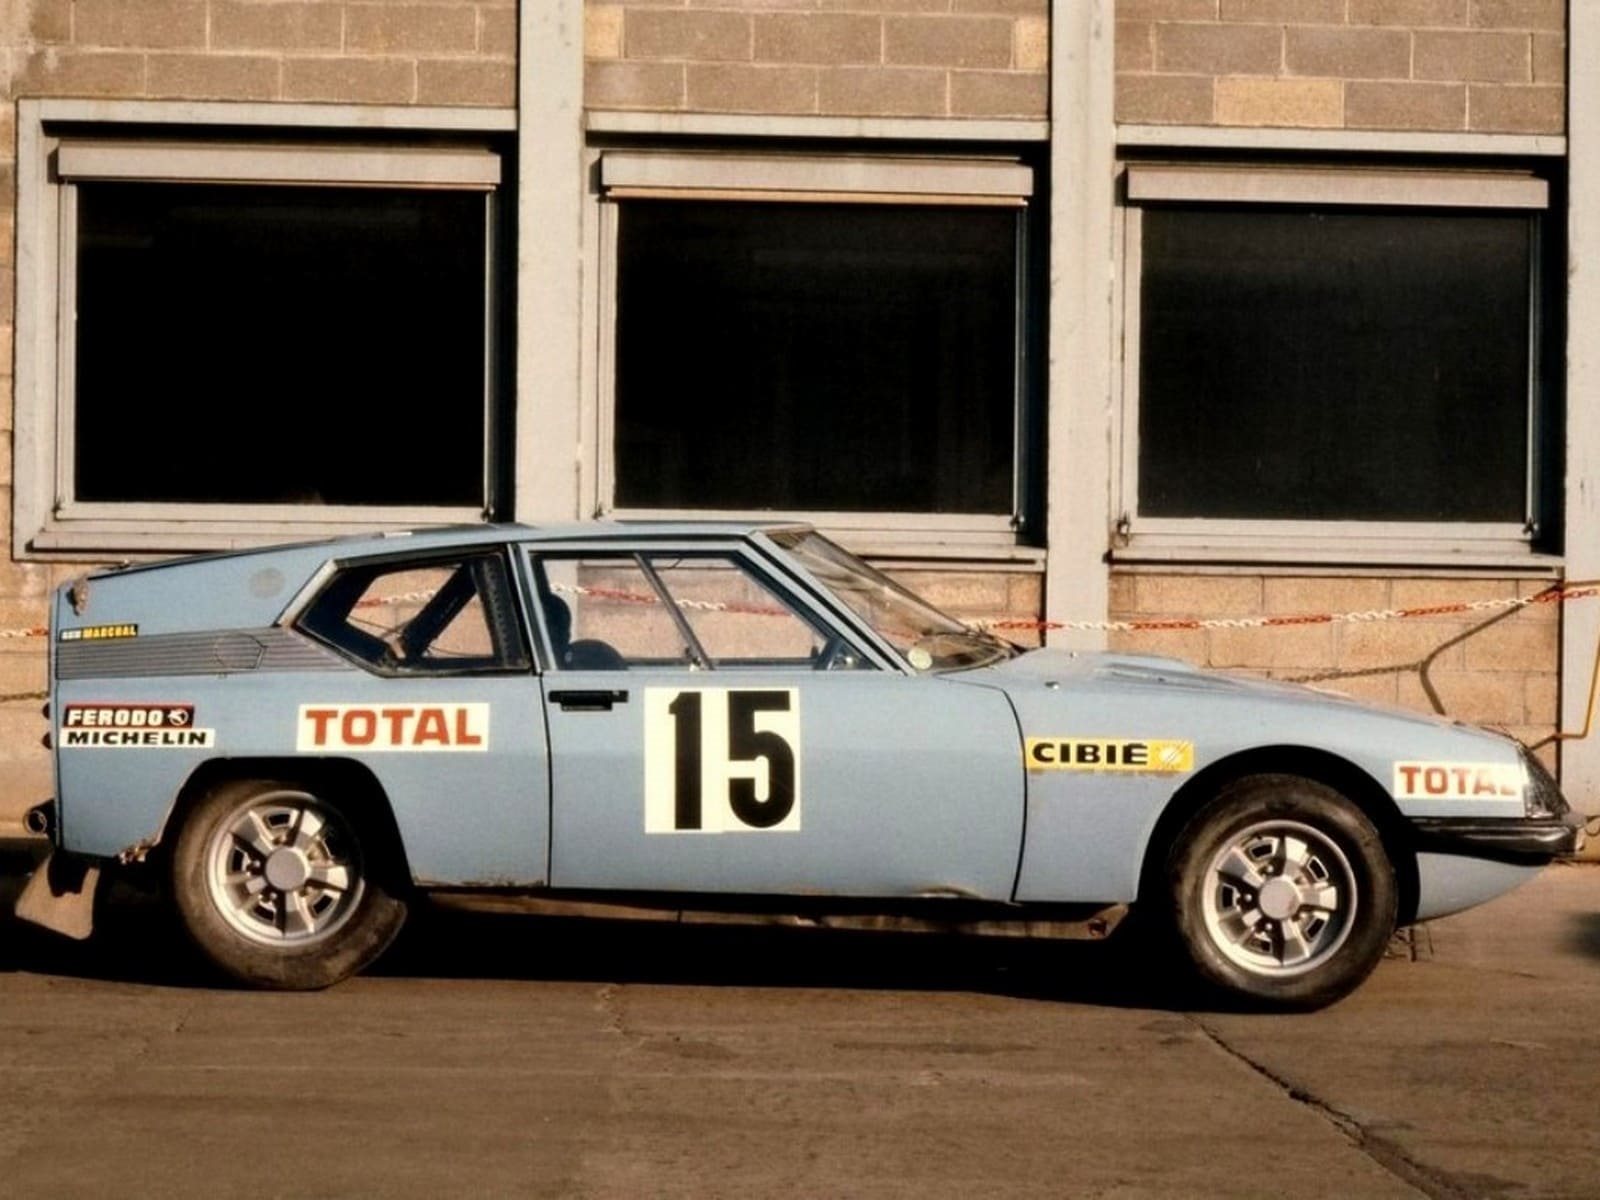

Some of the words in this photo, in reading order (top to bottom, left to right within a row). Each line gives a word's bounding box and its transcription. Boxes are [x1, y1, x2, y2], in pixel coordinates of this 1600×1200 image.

[67, 709, 164, 726] FERODO
[305, 708, 482, 745] TOTAL
[67, 731, 207, 745] MICHELIN
[668, 690, 796, 830] 15
